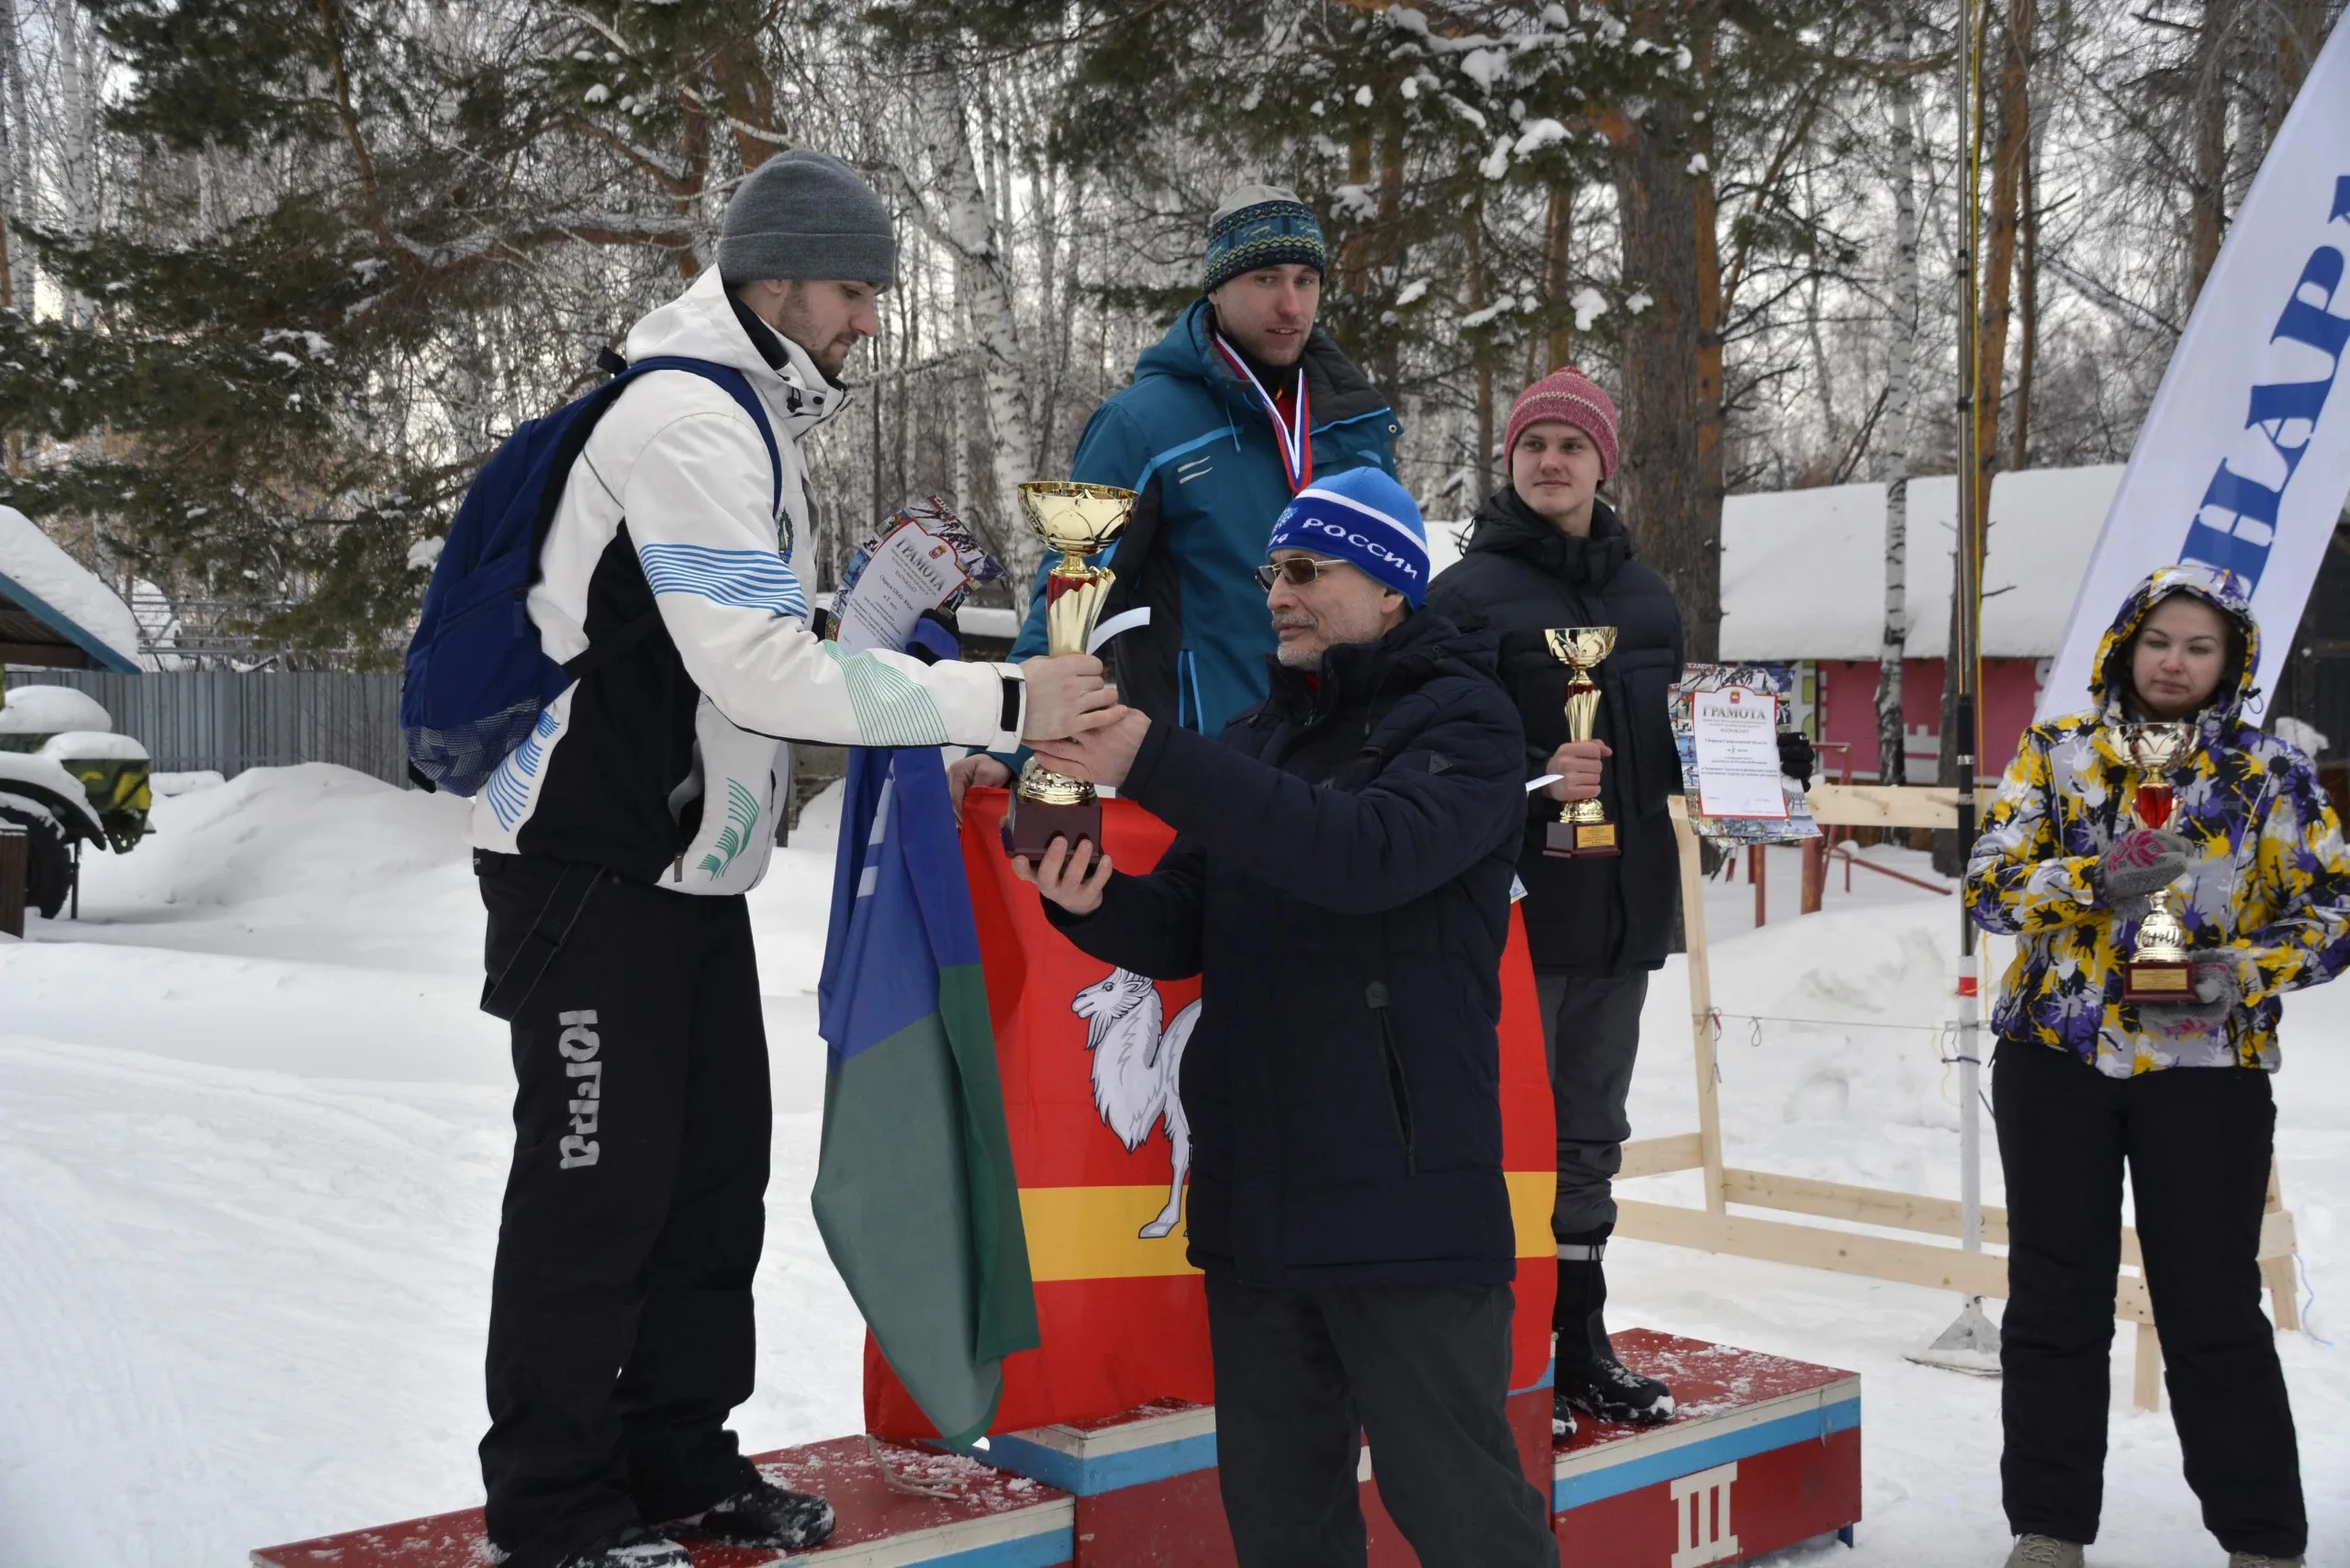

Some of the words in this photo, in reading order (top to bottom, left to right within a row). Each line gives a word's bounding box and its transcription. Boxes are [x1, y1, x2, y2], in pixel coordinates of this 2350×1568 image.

[896, 536, 946, 591] ГРАМОТА
[1301, 518, 1418, 580] РОССИИ
[1703, 705, 1766, 720] ГРАМОТА
[1670, 1461, 1738, 1568] III
